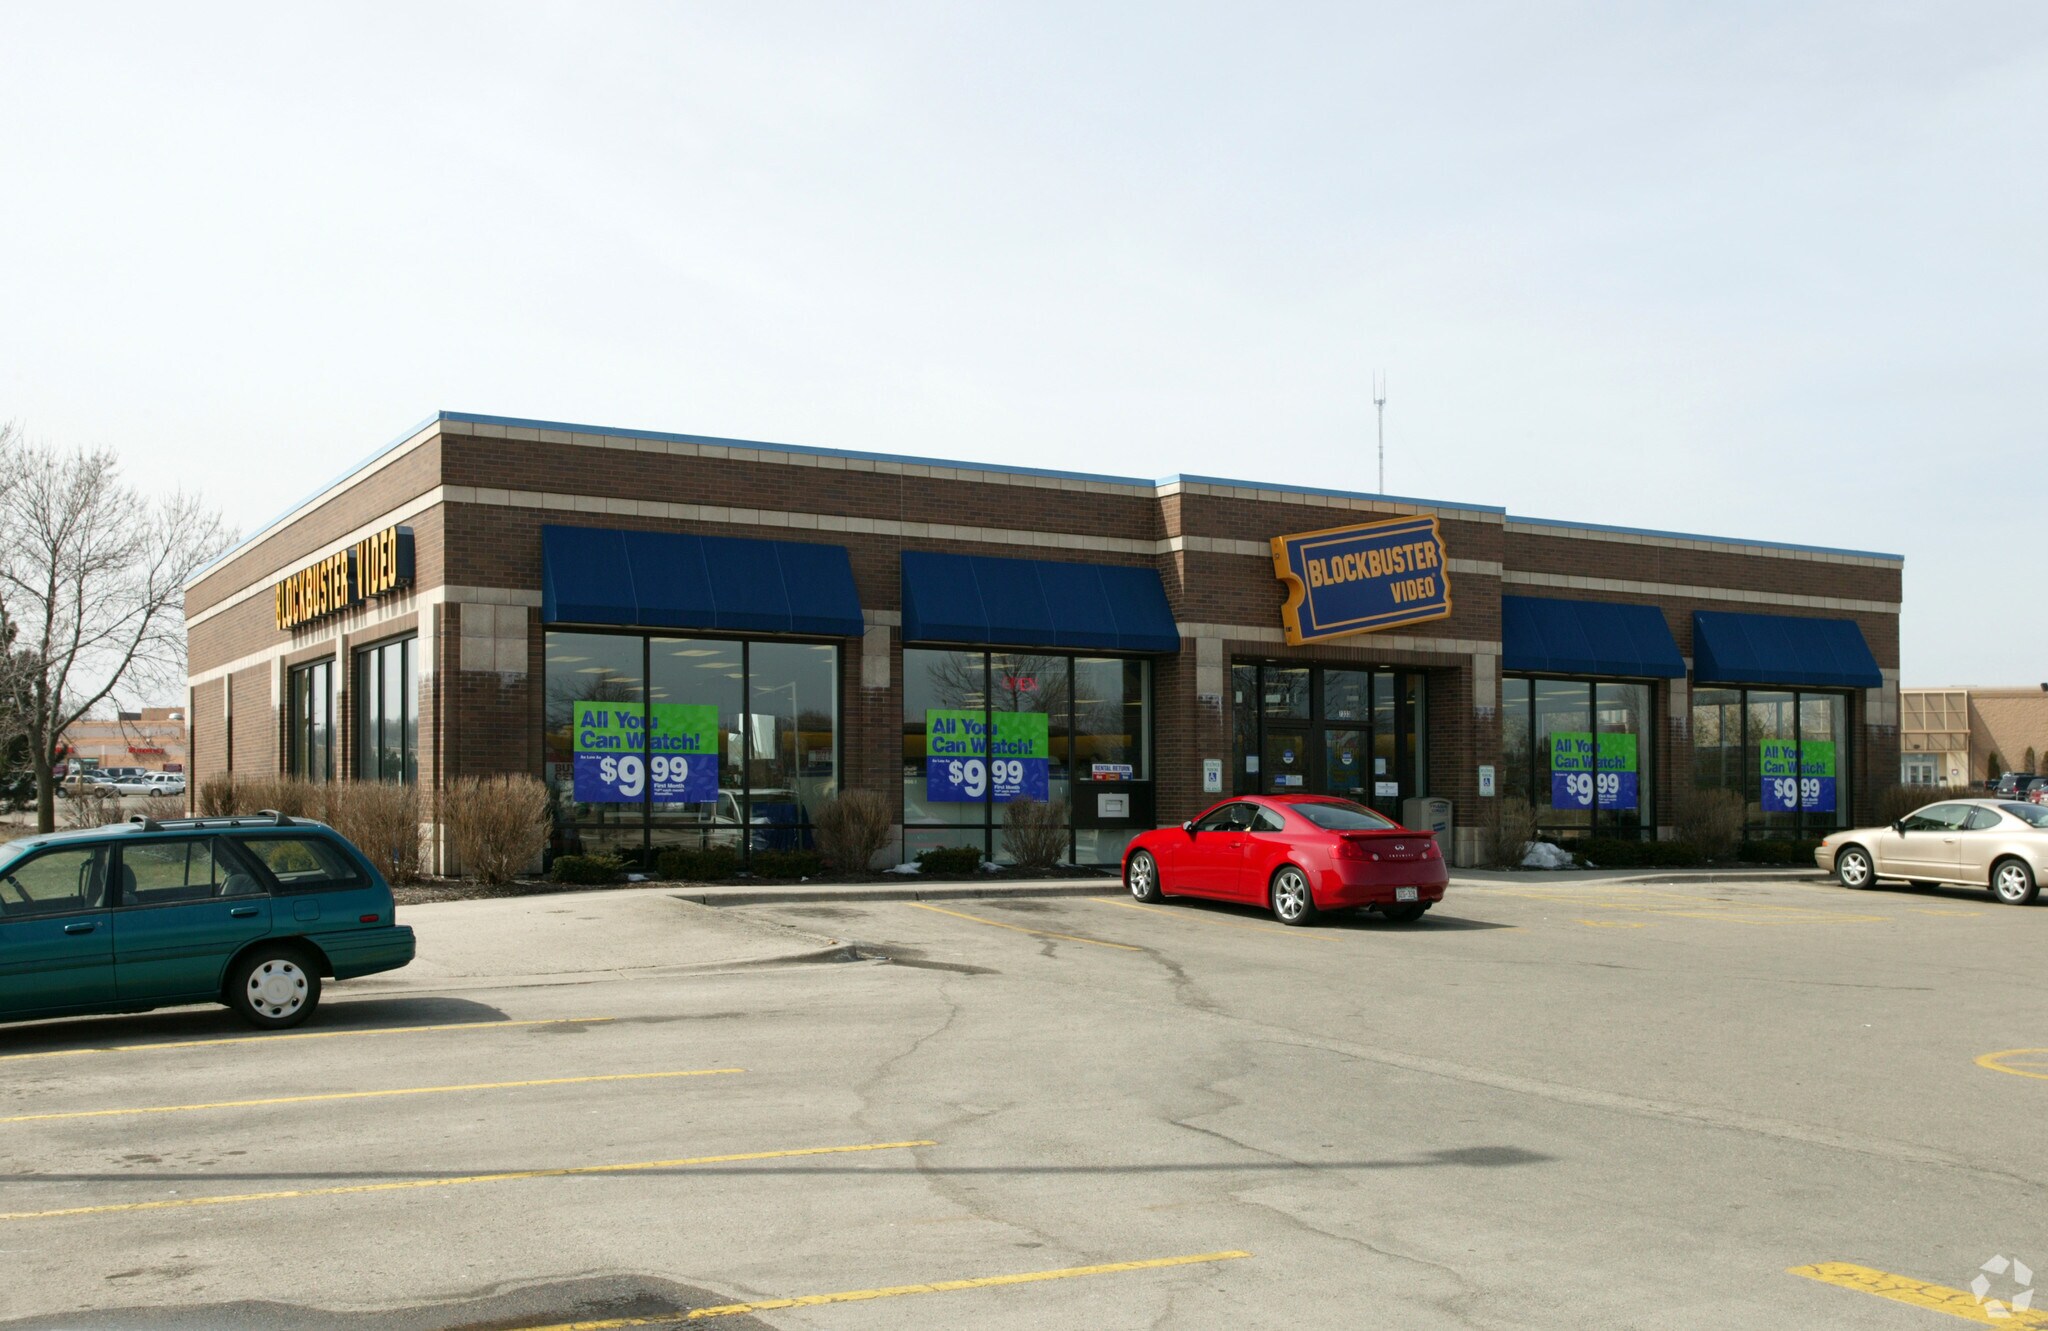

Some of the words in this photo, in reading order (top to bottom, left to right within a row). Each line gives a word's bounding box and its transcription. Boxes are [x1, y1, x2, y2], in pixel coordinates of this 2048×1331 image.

[1308, 541, 1438, 588] BLOCKBUSTER
[275, 549, 348, 631] BLOCKBUSTER
[356, 525, 397, 600] VIDEO
[1390, 576, 1436, 604] VIDEO
[580, 711, 608, 728] All
[615, 711, 658, 730] You
[932, 718, 956, 734] All
[961, 719, 998, 735] You
[580, 730, 620, 748] Can
[626, 732, 700, 750] Watch!
[932, 736, 966, 753] Can
[970, 738, 1033, 755] Watch!
[1555, 739, 1571, 752] All
[1575, 739, 1602, 753] You
[1555, 754, 1579, 768] Can
[1582, 755, 1626, 769] Watch!
[1764, 746, 1778, 759] All
[1764, 760, 1785, 773] Can
